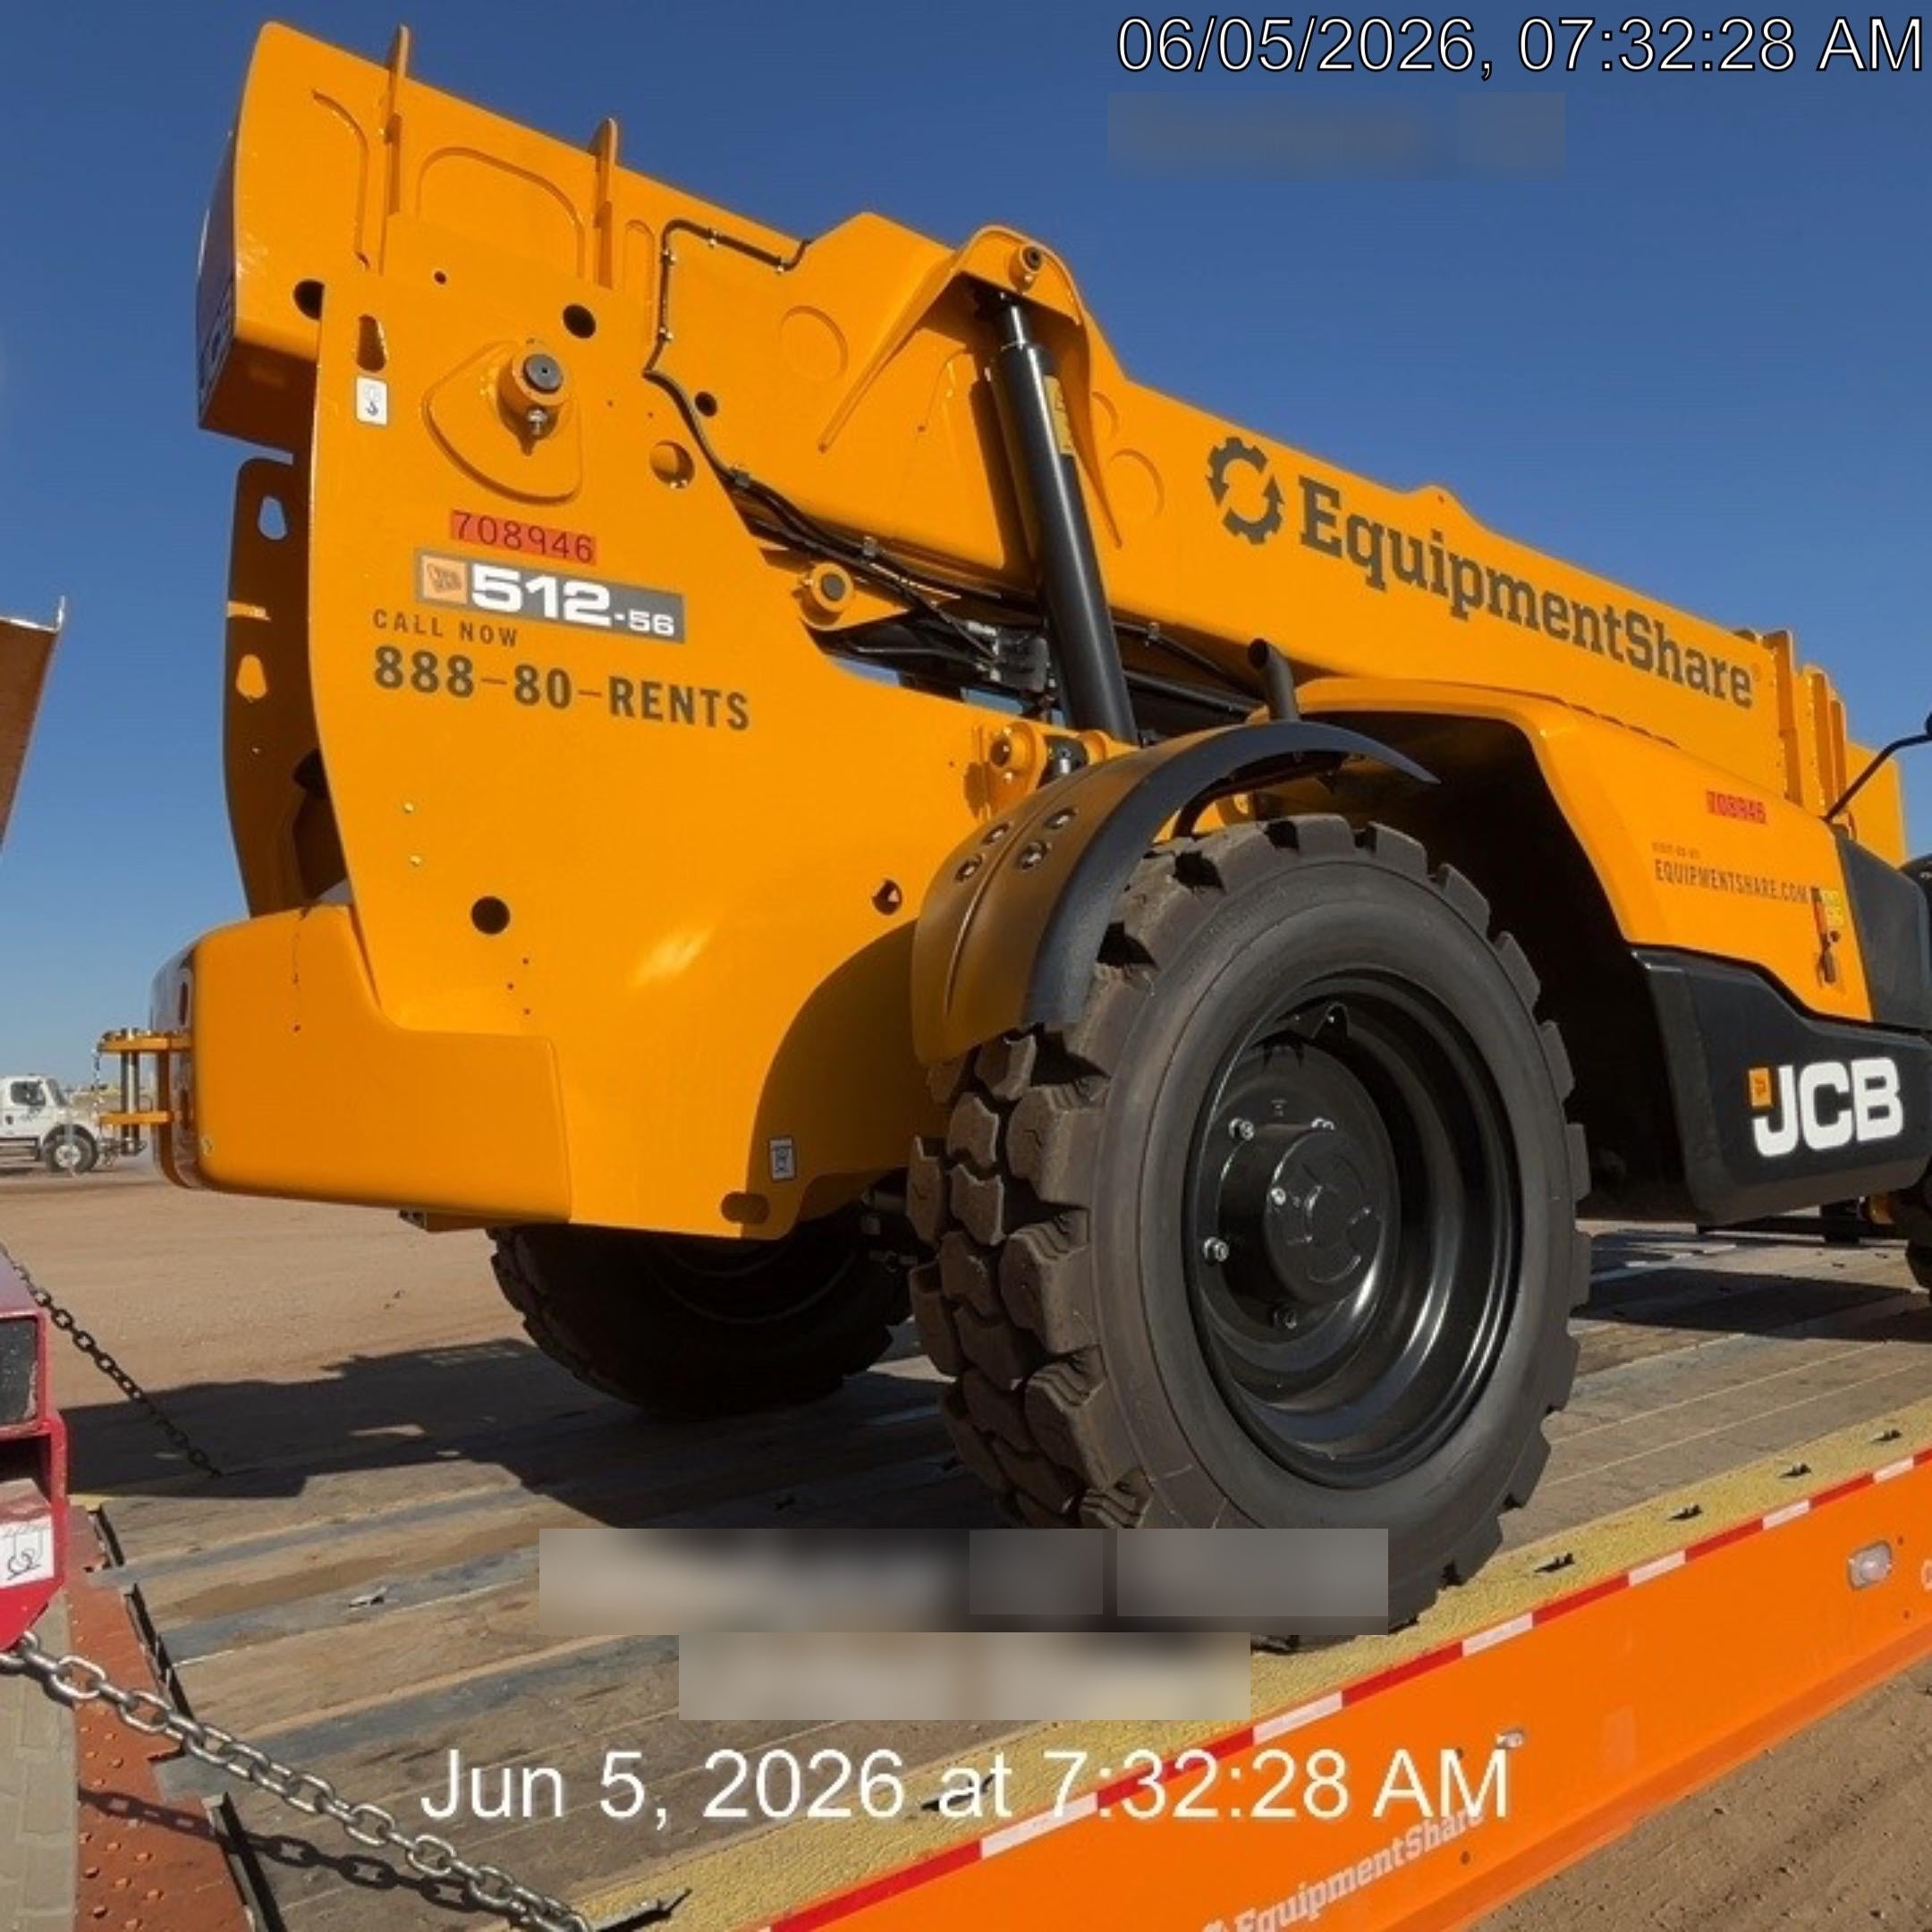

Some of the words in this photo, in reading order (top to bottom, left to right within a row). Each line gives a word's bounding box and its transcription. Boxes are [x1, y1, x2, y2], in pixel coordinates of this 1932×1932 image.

[453, 511, 596, 562] 708946
[1297, 475, 1754, 709] EquipmentShare
[373, 608, 445, 638] CALL
[459, 622, 519, 648] NOW
[374, 646, 750, 732] 888-80-RENTS
[1655, 859, 1809, 904] EQUIPMENTSHARE.COM
[1752, 1056, 1903, 1157] JCB
